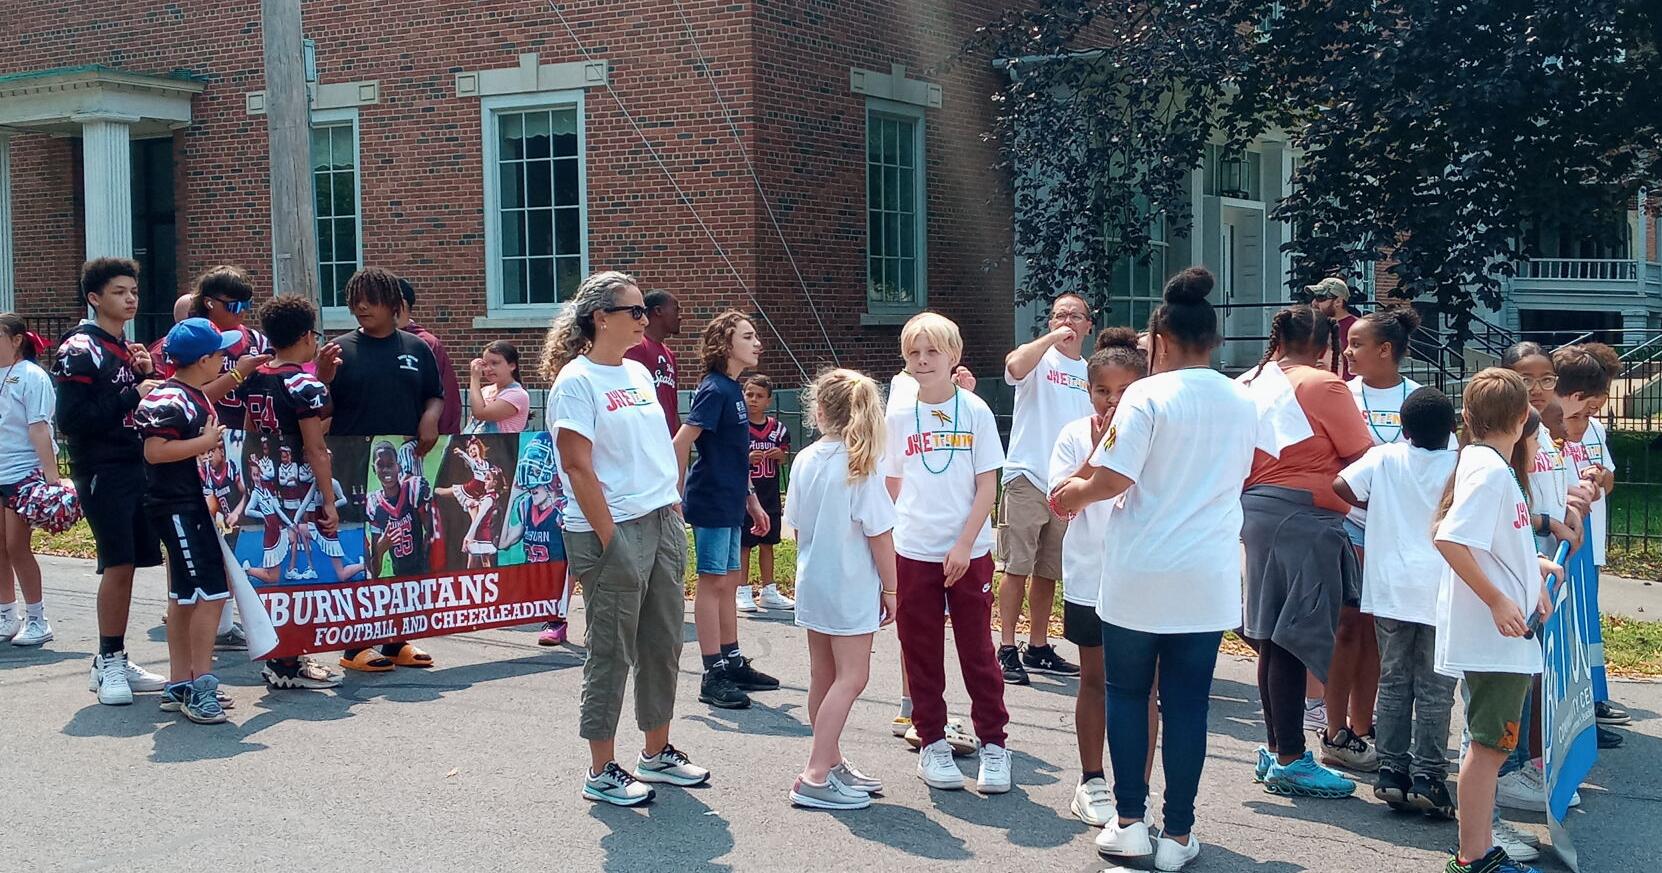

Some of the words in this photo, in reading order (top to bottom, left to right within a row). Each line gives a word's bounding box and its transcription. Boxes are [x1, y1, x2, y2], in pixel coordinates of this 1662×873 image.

[259, 587, 356, 627] BURN
[356, 573, 499, 619] SPARTANS
[314, 619, 397, 647] FOOTBALL
[400, 615, 428, 635] AND
